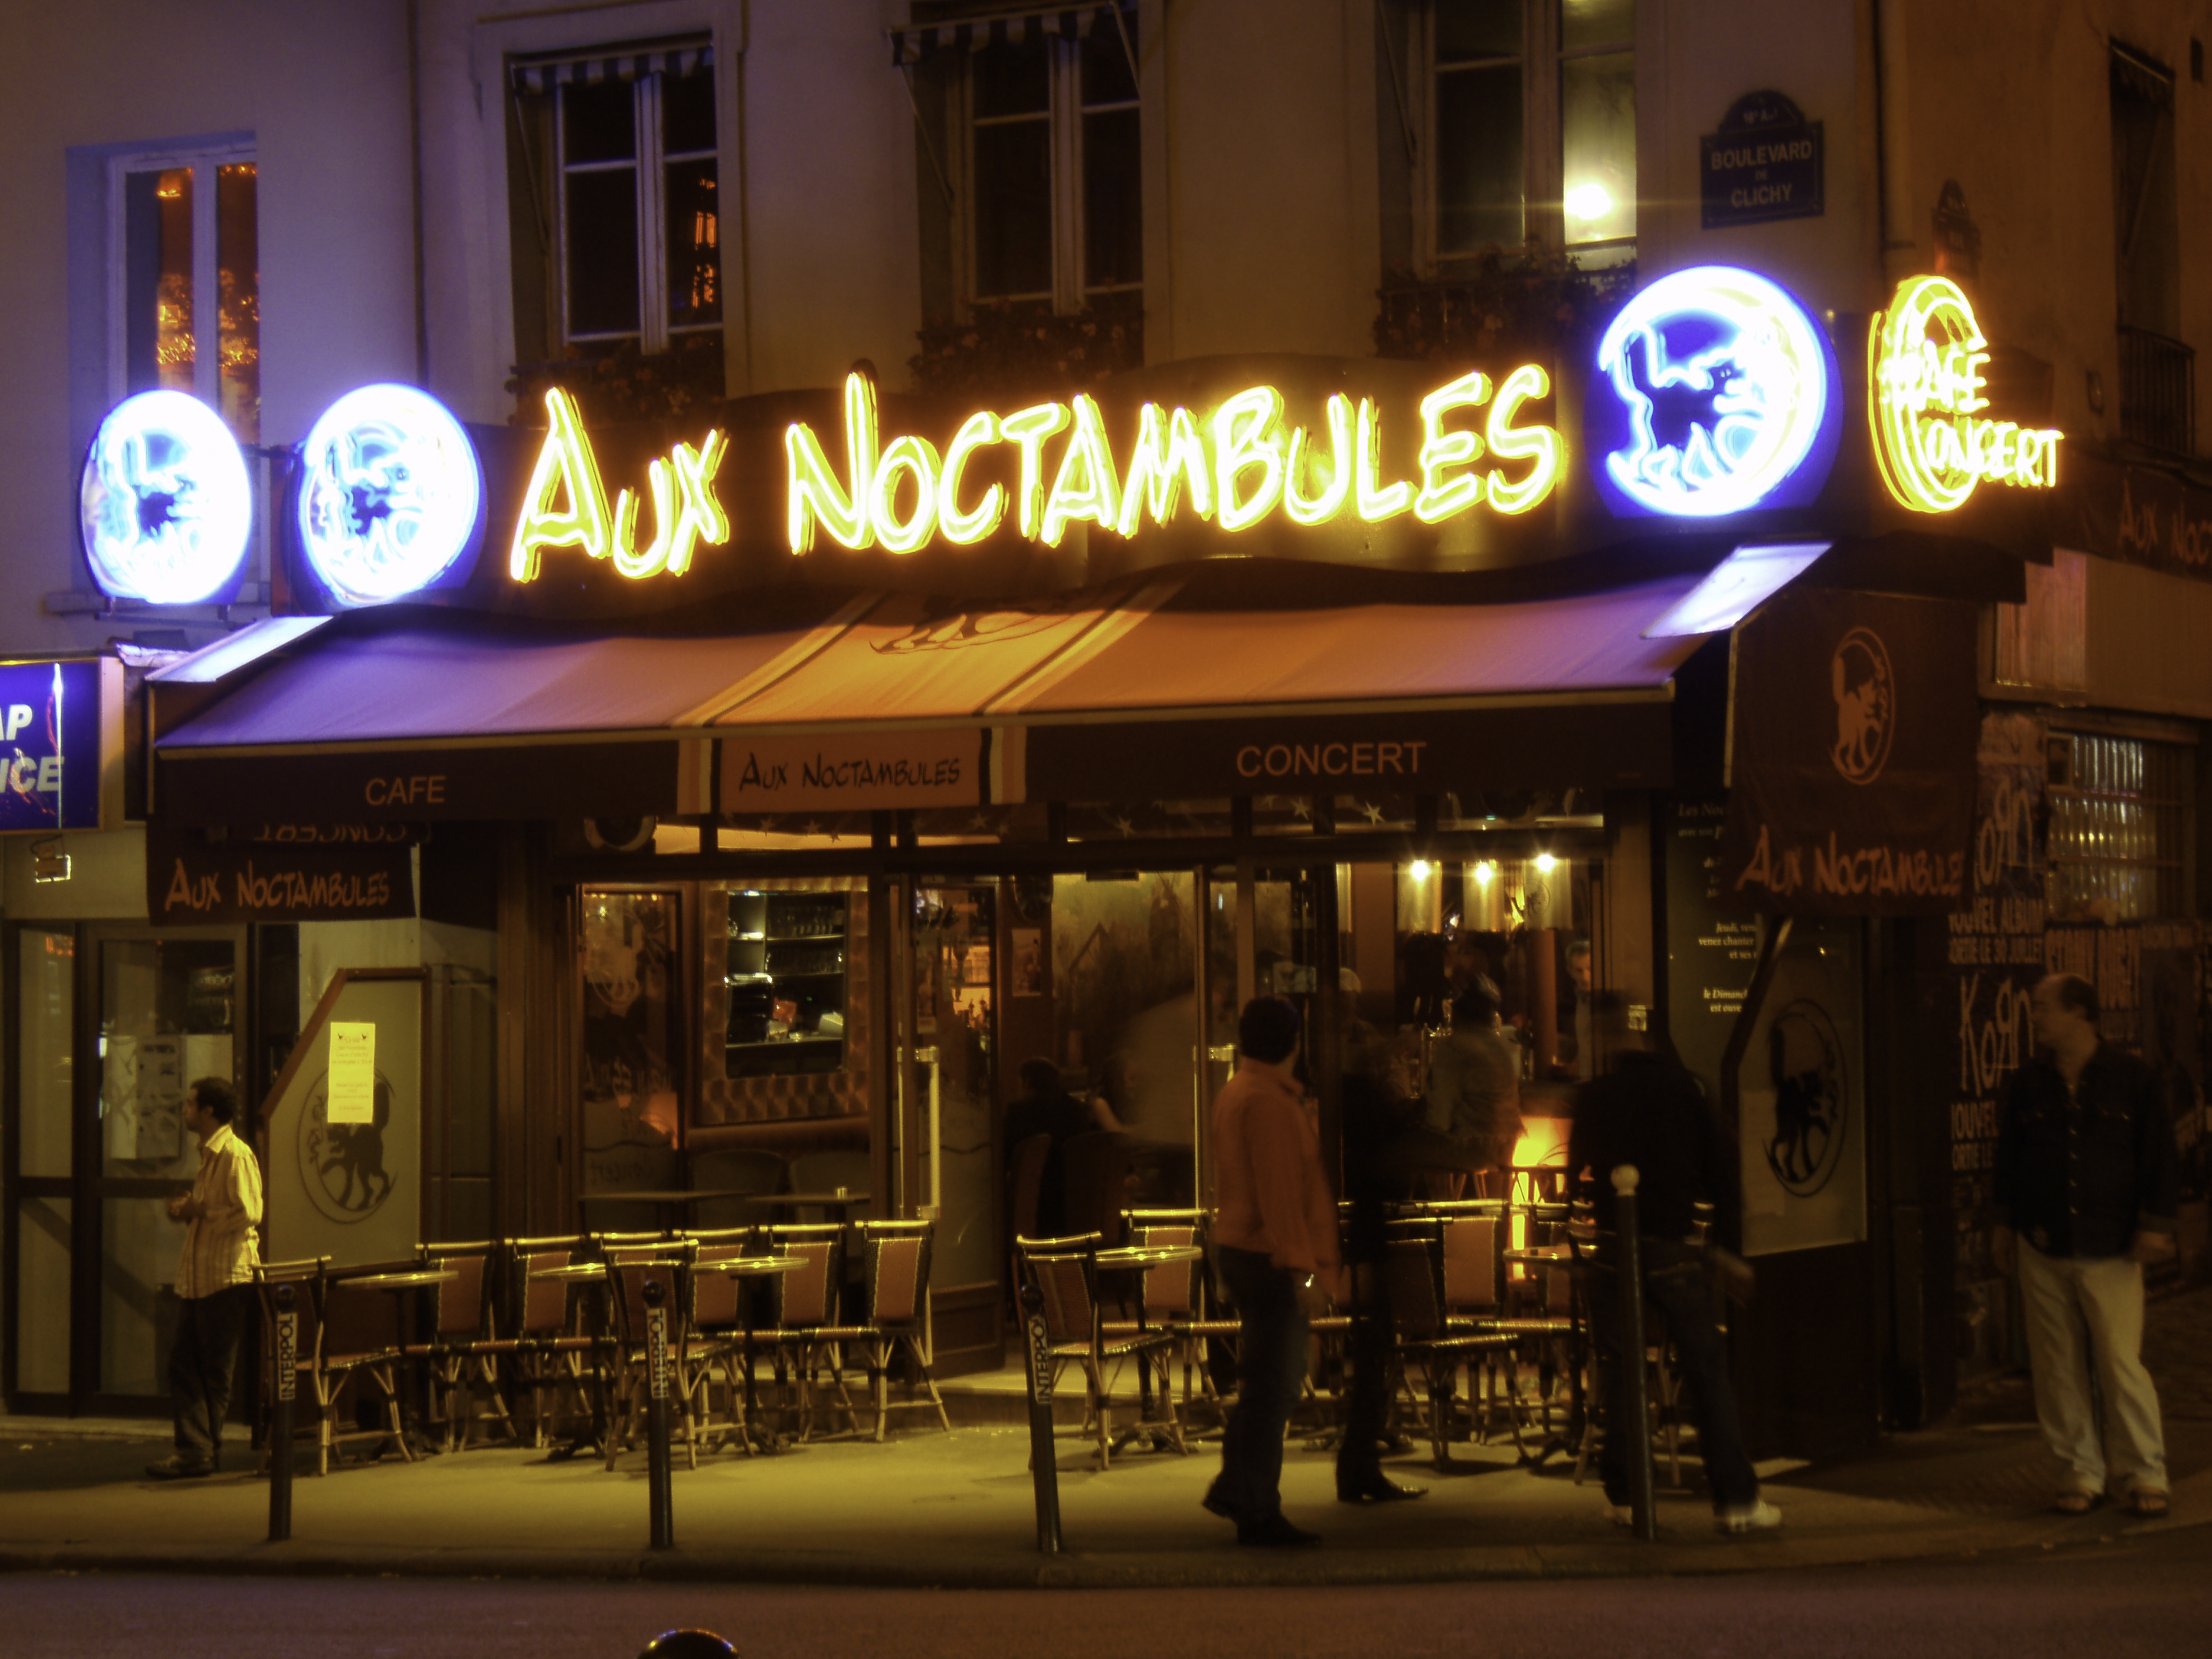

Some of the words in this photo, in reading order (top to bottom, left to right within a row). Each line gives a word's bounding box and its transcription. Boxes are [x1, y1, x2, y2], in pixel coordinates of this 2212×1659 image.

[1711, 140, 1812, 171] BOULEVARD
[1731, 183, 1793, 208] CLICHY
[511, 386, 729, 583] AUX
[785, 364, 1567, 554] NOCTAMBULES
[2170, 500, 2212, 565] NOC
[0, 703, 33, 741] P
[738, 752, 788, 791] AUX
[801, 752, 961, 789] NOCTAMBULES
[1236, 741, 1427, 778] CONCERT
[365, 775, 446, 806] CAFE
[165, 858, 221, 912] AUX
[238, 860, 390, 909] NOCTAMBULES
[279, 1314, 296, 1399] INTERPOL
